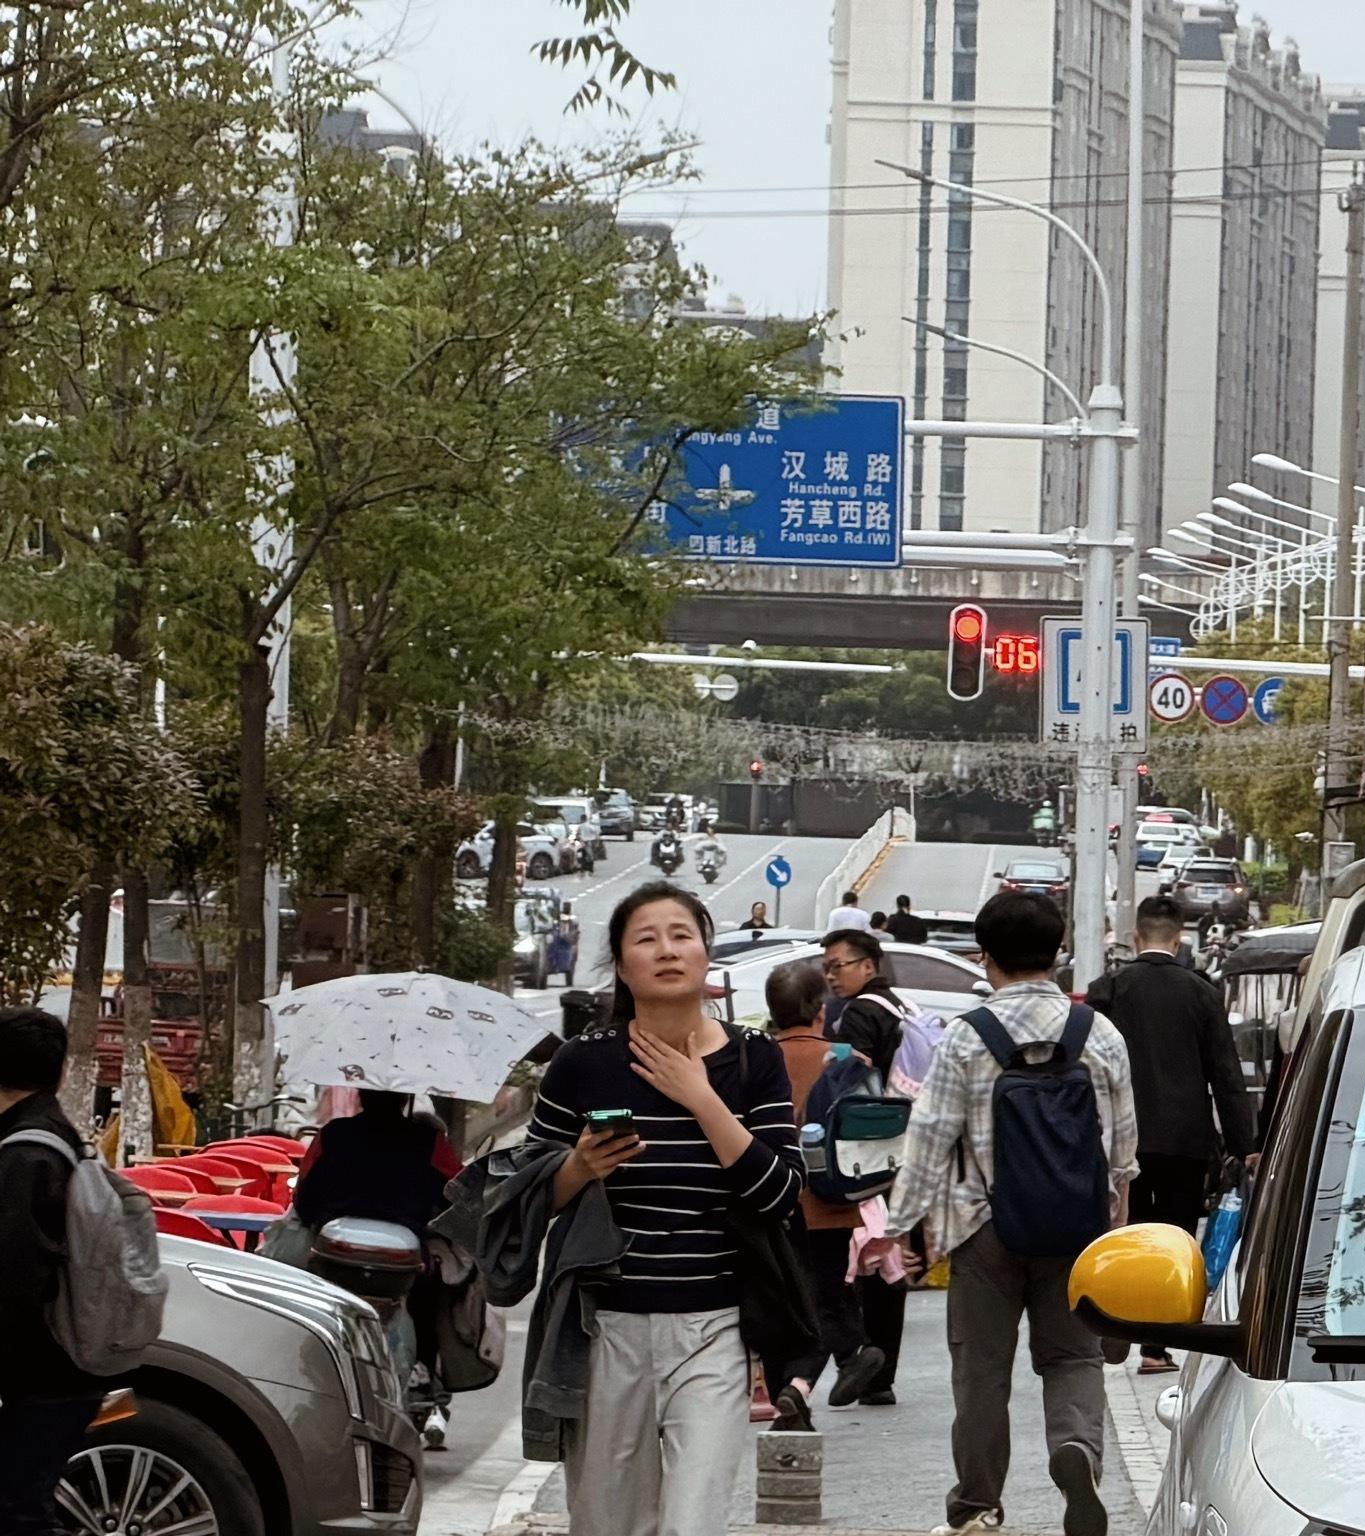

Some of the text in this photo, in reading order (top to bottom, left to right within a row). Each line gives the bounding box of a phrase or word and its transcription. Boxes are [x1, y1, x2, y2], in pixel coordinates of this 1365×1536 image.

[748, 431, 777, 444] Ave.
[780, 450, 893, 483] 汉城路
[788, 481, 886, 498] Hancheng Rd.
[780, 498, 892, 531] 芳草西路
[780, 531, 838, 546] Fangcao
[996, 636, 1038, 671] 06
[1157, 686, 1186, 709] 40
